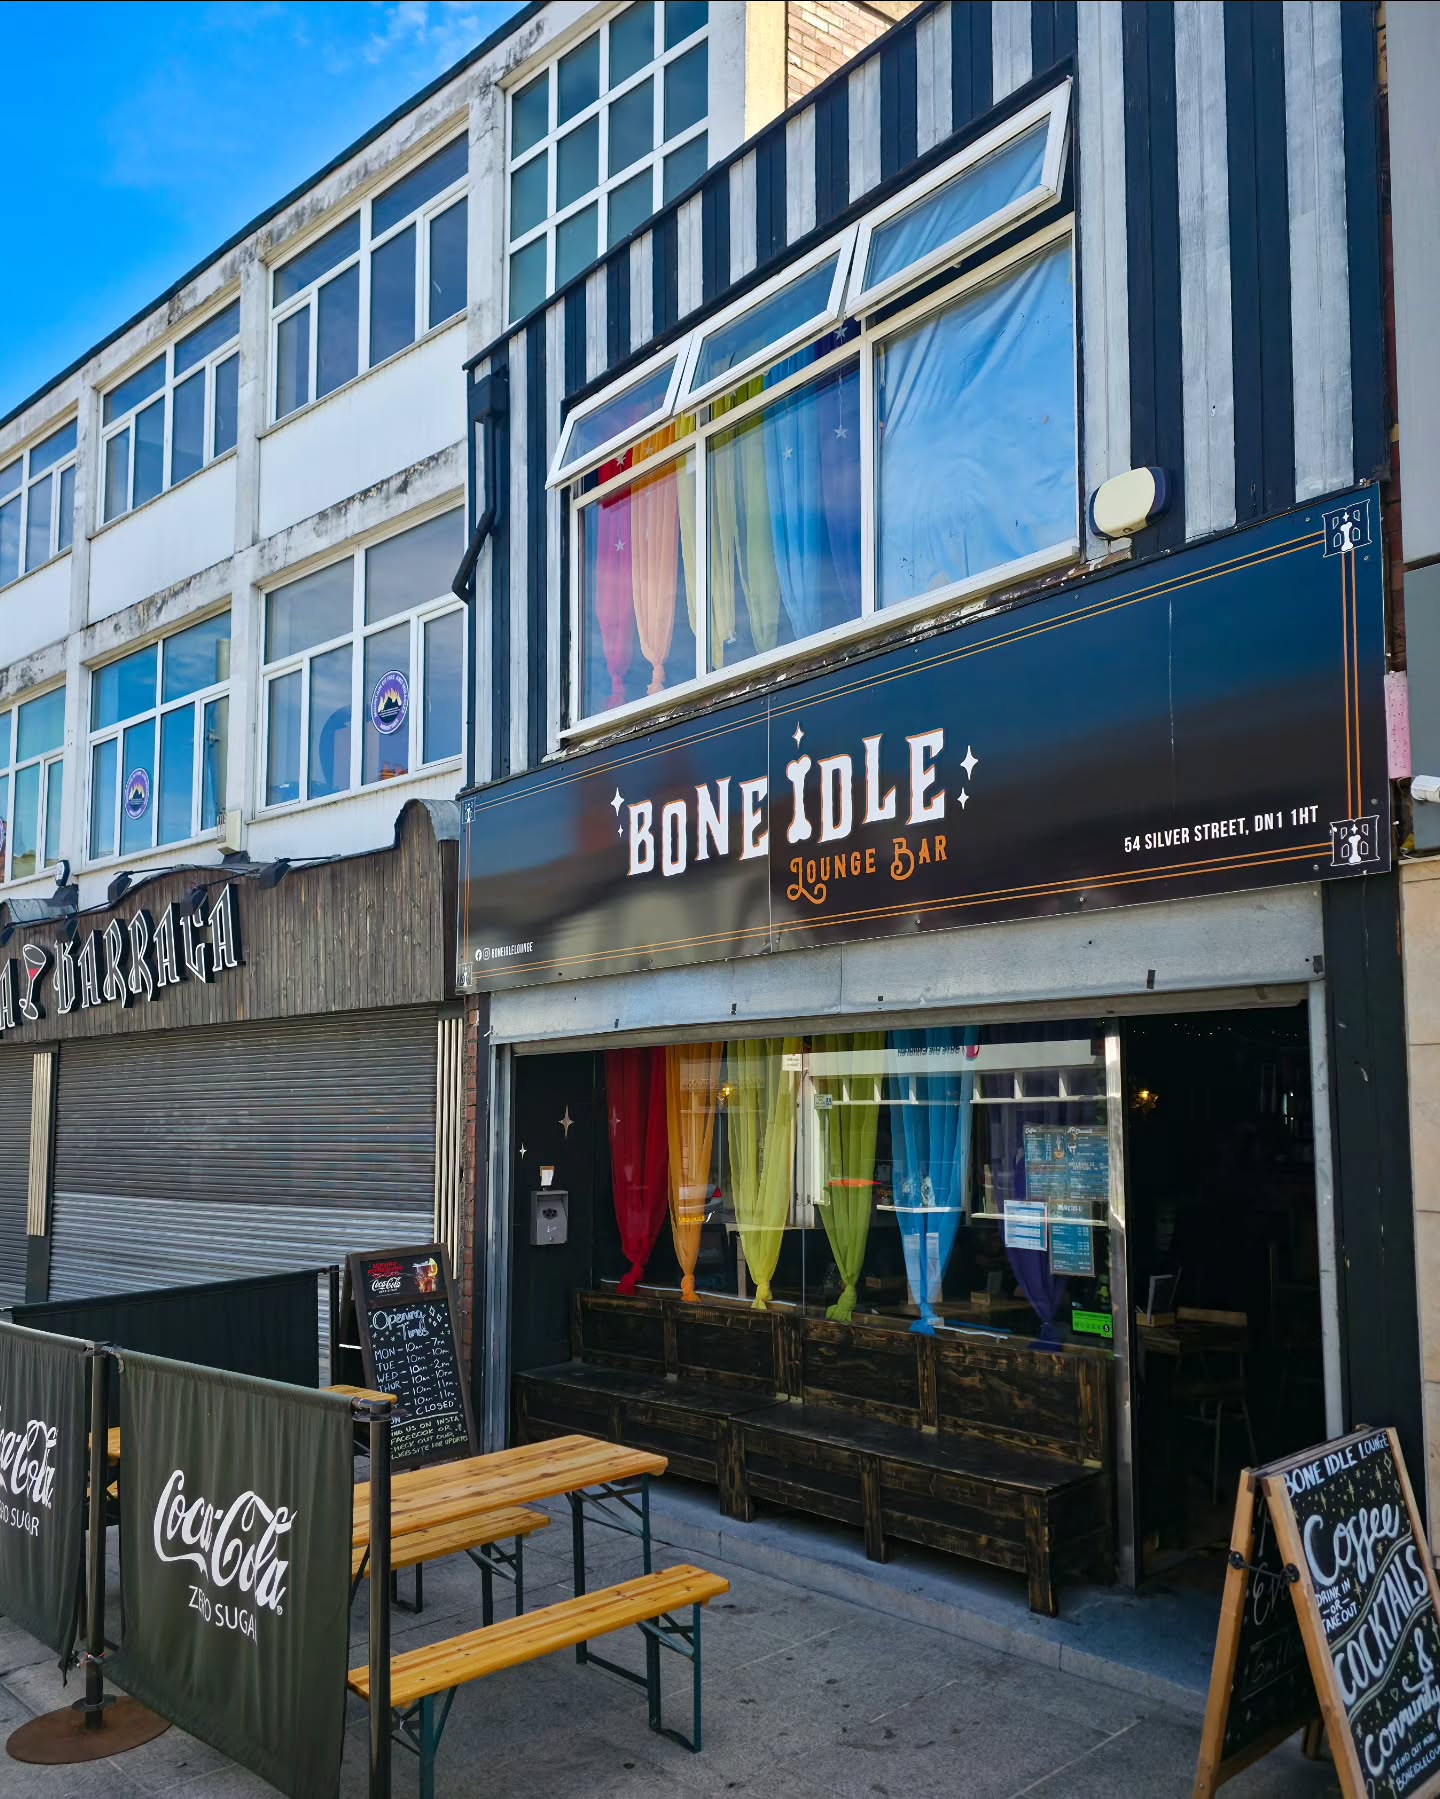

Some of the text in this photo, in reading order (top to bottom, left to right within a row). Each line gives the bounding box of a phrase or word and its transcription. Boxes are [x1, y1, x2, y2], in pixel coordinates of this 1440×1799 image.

[627, 728, 946, 877] BONE IDLE
[1124, 804, 1319, 853] 54 SILVER STREET, DN1 1HT
[786, 835, 948, 905] LOUNGE BAR
[371, 1277, 402, 1292] Coca-Cola
[373, 1310, 427, 1330] Opening
[397, 1321, 429, 1340] Times
[374, 1347, 396, 1360] MON
[376, 1361, 395, 1372] TUE
[376, 1371, 399, 1383] WED
[415, 1400, 454, 1415] CLOSED
[419, 1421, 432, 1429] ON
[436, 1416, 459, 1426] INSTA
[417, 1436, 434, 1444] OUT
[1284, 1432, 1390, 1498] BONE IDLE LOUNGE
[154, 1469, 297, 1610] Coca-Cola
[1304, 1503, 1400, 1587] Coffee
[1315, 1577, 1351, 1607] DRINK IN
[1322, 1601, 1358, 1634] TAKE OUT
[1333, 1545, 1429, 1706] COCKTAILS
[1414, 1627, 1434, 1674] &
[1396, 1752, 1411, 1771] FIND
[1410, 1743, 1423, 1758] OUT
